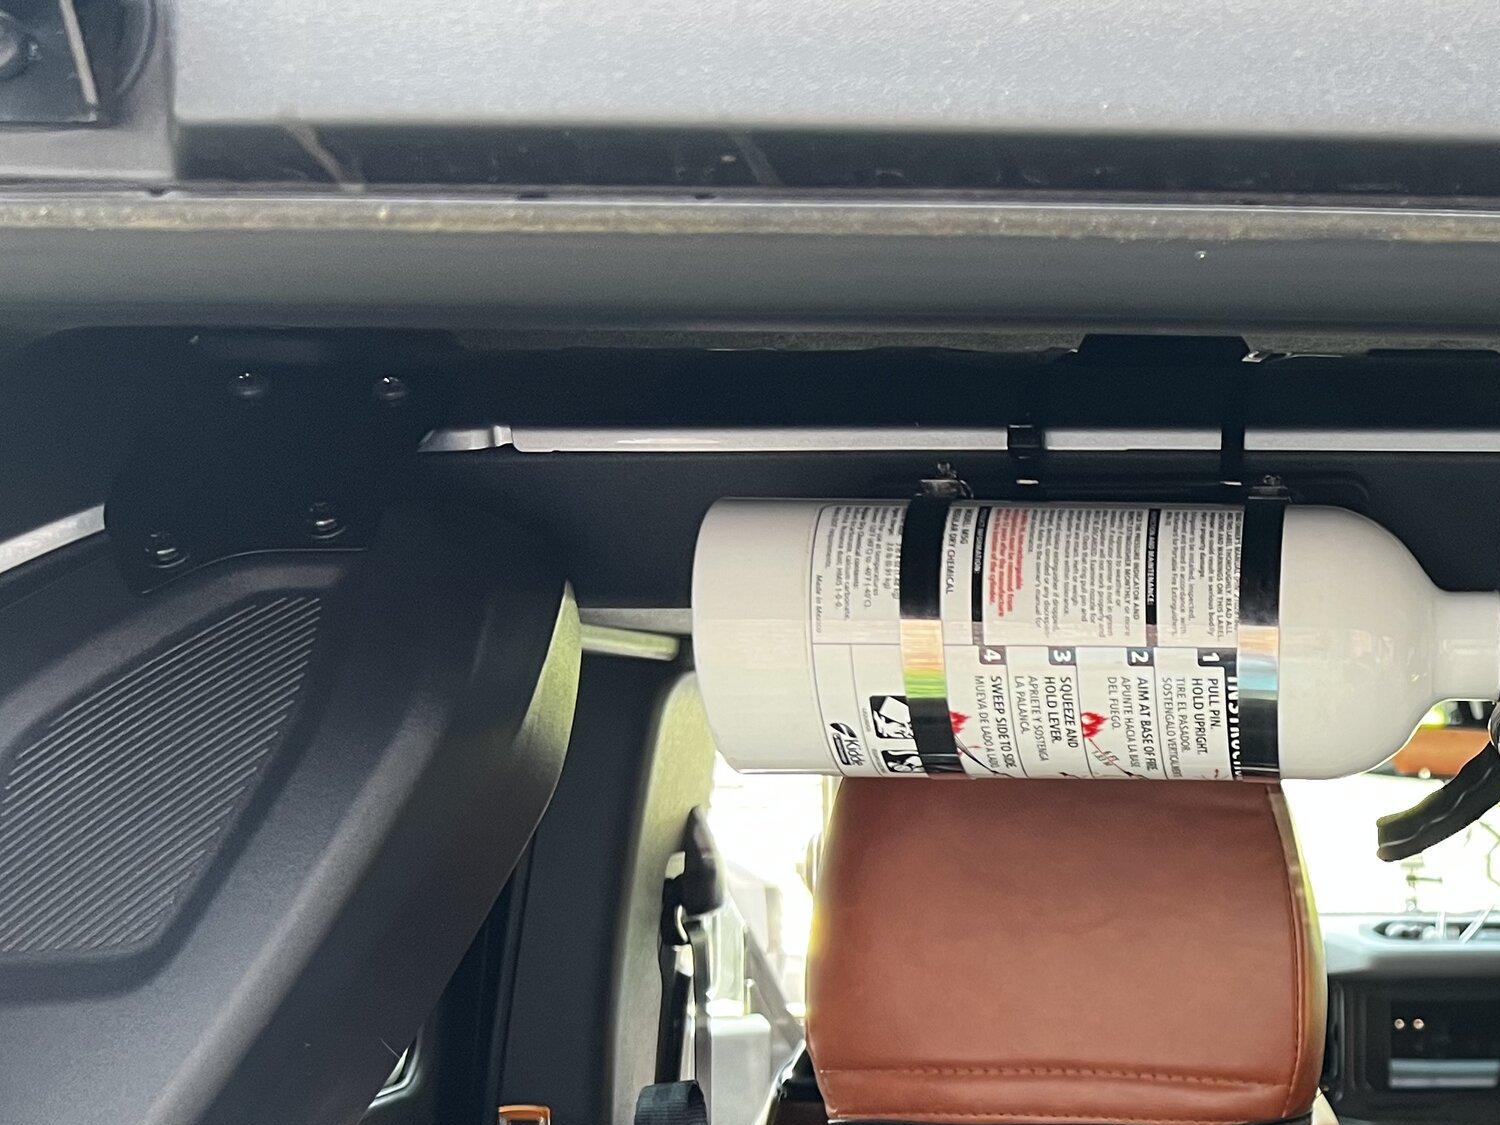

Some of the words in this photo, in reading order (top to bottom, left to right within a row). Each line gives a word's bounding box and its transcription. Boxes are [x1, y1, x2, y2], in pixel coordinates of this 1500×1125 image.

[855, 532, 865, 557] Chemical
[949, 534, 957, 547] DRY
[845, 555, 853, 580] calcium
[946, 550, 956, 594] CHEMICAL
[1080, 566, 1088, 579] ring
[883, 578, 893, 590] kg)
[1080, 581, 1088, 593] pull
[1217, 583, 1223, 594] ON
[1080, 595, 1088, 606] pin
[1097, 591, 1105, 622] properly
[1116, 599, 1121, 607] or
[1125, 606, 1130, 614] or
[1207, 612, 1215, 636] bodily
[984, 648, 1002, 661] 4
[1053, 650, 1071, 662] 3
[1131, 651, 1149, 663] 2
[1202, 653, 1220, 662] 1
[975, 676, 988, 709] MUEVA
[1015, 676, 1025, 688] LA
[1044, 676, 1058, 708] HOLD
[1107, 677, 1117, 695] DEL
[1137, 677, 1150, 701] AIM
[1176, 677, 1186, 698] TIRE
[1207, 678, 1220, 706] PULL
[990, 676, 1005, 715] SWEEP
[1028, 676, 1041, 714] APRIETE
[1060, 676, 1075, 726] SQUEEZE
[1121, 677, 1134, 715] APUNTE
[1191, 678, 1204, 710] HOLD
[1016, 691, 1029, 735] PALANCA.
[1109, 698, 1121, 729] FUEGO.
[1139, 703, 1151, 716] AT
[1162, 677, 1177, 736] SOSTENGALO
[1177, 702, 1187, 711] EL
[980, 712, 991, 723] DE
[1048, 712, 1062, 743] LEVER.
[1209, 710, 1221, 729] PIN.
[981, 726, 994, 746] LADO
[996, 718, 1009, 739] SIDE
[1066, 728, 1078, 748] AND
[1125, 718, 1137, 743] HACIA
[1141, 721, 1153, 744] BASE
[1194, 714, 1208, 755] UPRIGHT.
[844, 739, 865, 766] Kidde
[1000, 742, 1011, 752] TO
[1034, 726, 1049, 761] SOSTENGA
[1128, 745, 1137, 753] LA
[1143, 746, 1155, 756] OF
[1129, 754, 1140, 768] BASE
